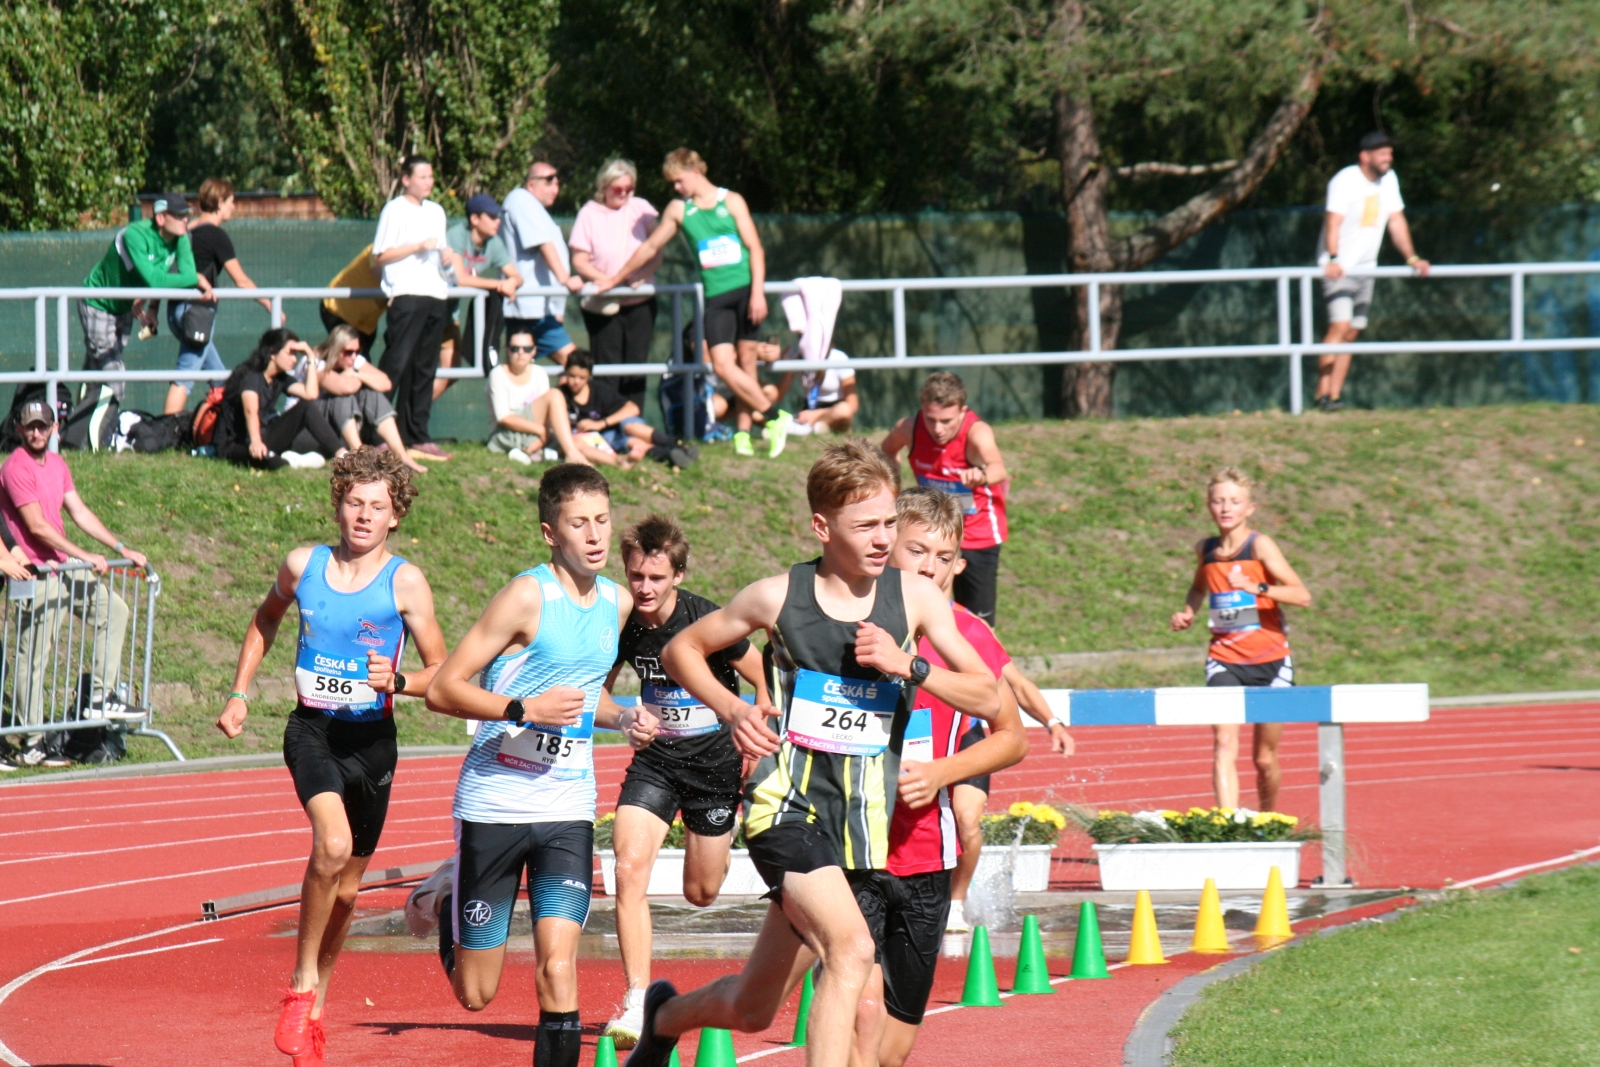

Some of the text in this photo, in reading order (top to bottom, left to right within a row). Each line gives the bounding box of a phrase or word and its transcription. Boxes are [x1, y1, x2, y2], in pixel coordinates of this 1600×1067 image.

[314, 653, 346, 671] ČESKÁ
[313, 664, 342, 676] spořitelna
[314, 675, 353, 695] 586
[823, 679, 864, 698] ČESKÁ
[654, 688, 681, 700] ČESKÁ
[821, 694, 859, 706] spořitelna
[306, 699, 328, 708] ŽACTVA
[661, 707, 691, 722] 537
[821, 707, 868, 732] 264
[536, 733, 574, 758] 185
[808, 738, 836, 750] ŽACTVA
[504, 756, 519, 767] MČR
[518, 760, 543, 772] ŽACTVA
